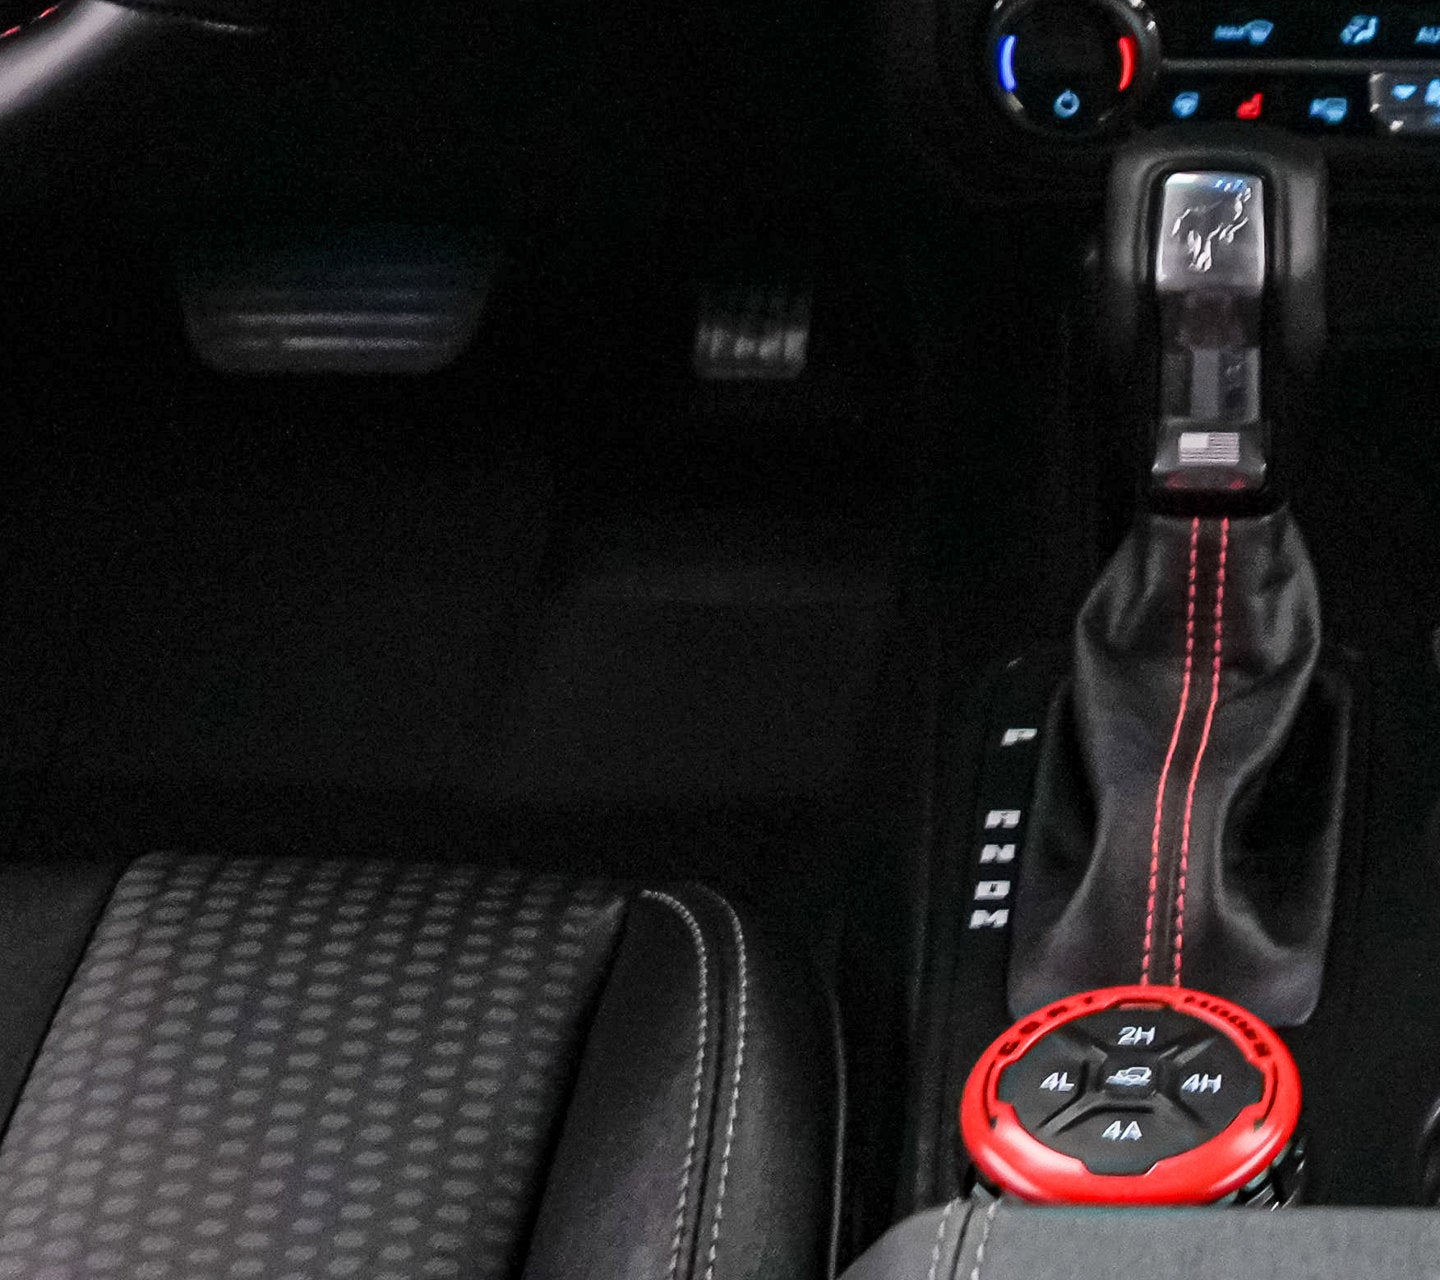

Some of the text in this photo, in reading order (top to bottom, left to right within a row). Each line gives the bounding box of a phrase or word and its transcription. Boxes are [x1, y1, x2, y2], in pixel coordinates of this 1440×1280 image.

[1001, 728, 1038, 747] P
[979, 843, 1016, 864] N
[973, 880, 1011, 901] D
[968, 909, 1010, 929] M
[1117, 1026, 1156, 1046] 2H
[1039, 1071, 1222, 1094] 4L 4H
[1101, 1120, 1143, 1141] 4A
